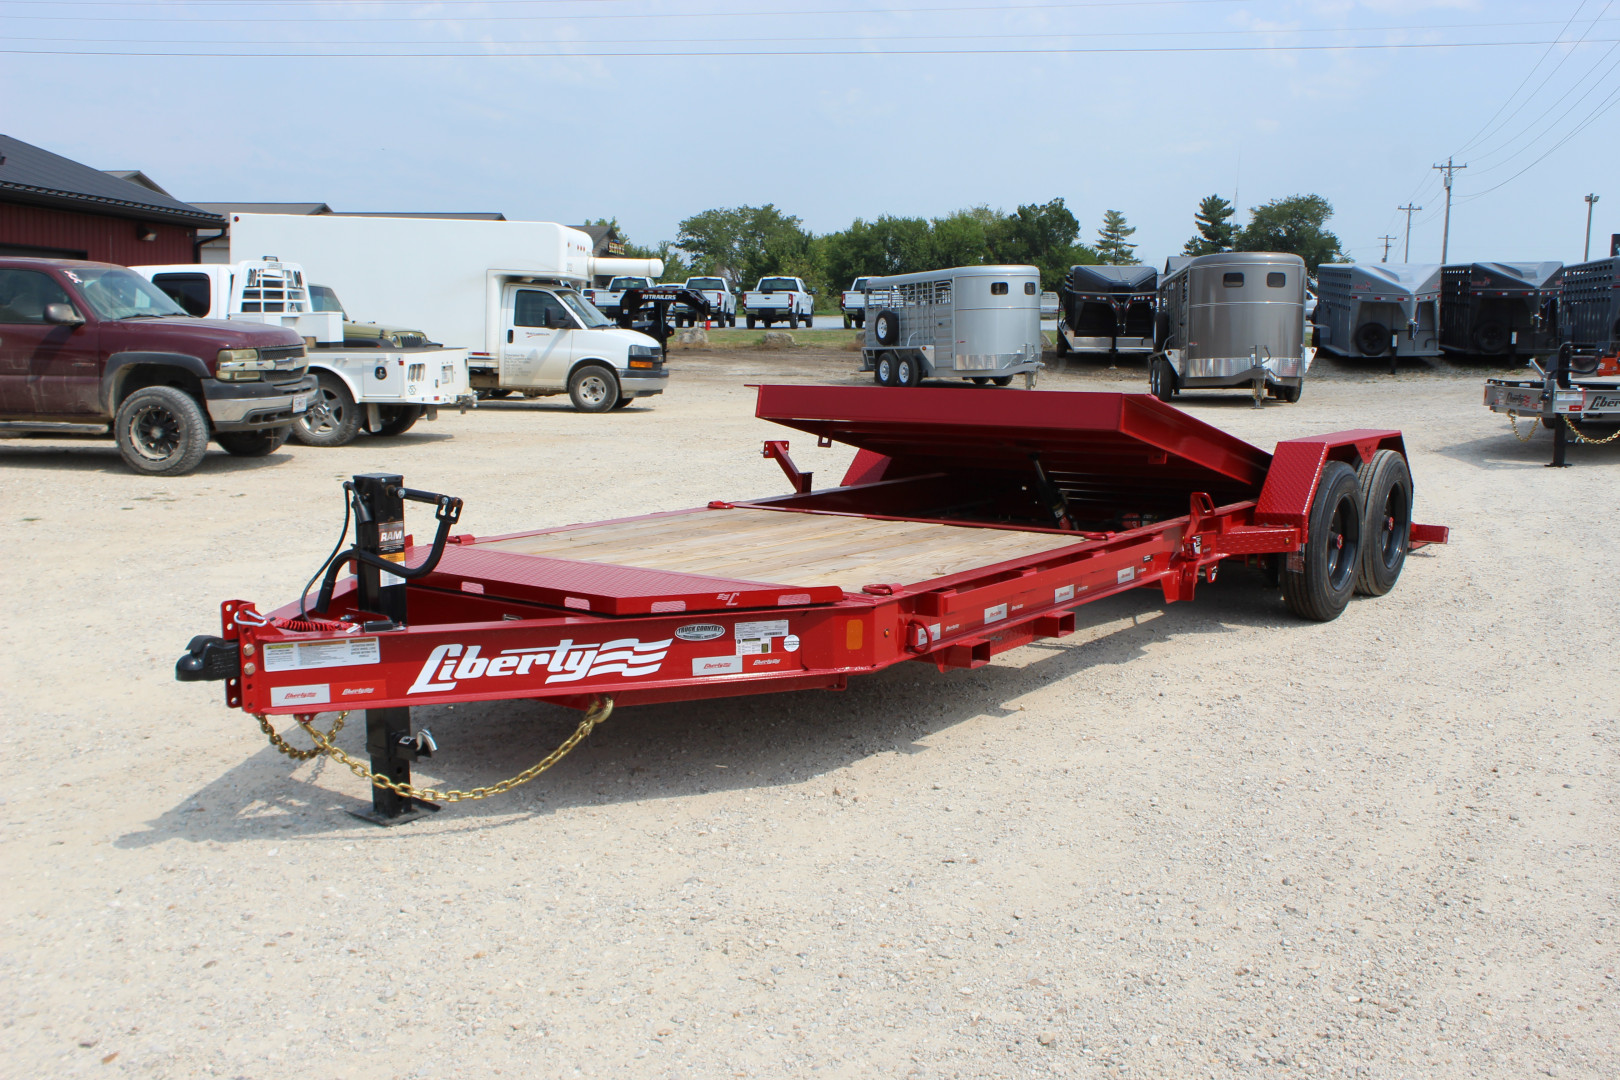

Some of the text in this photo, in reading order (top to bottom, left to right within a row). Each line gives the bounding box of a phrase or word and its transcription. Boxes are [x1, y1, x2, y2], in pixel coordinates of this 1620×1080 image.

[380, 530, 402, 542] RAM
[406, 638, 600, 695] Liberty
[284, 692, 308, 700] Liberty
